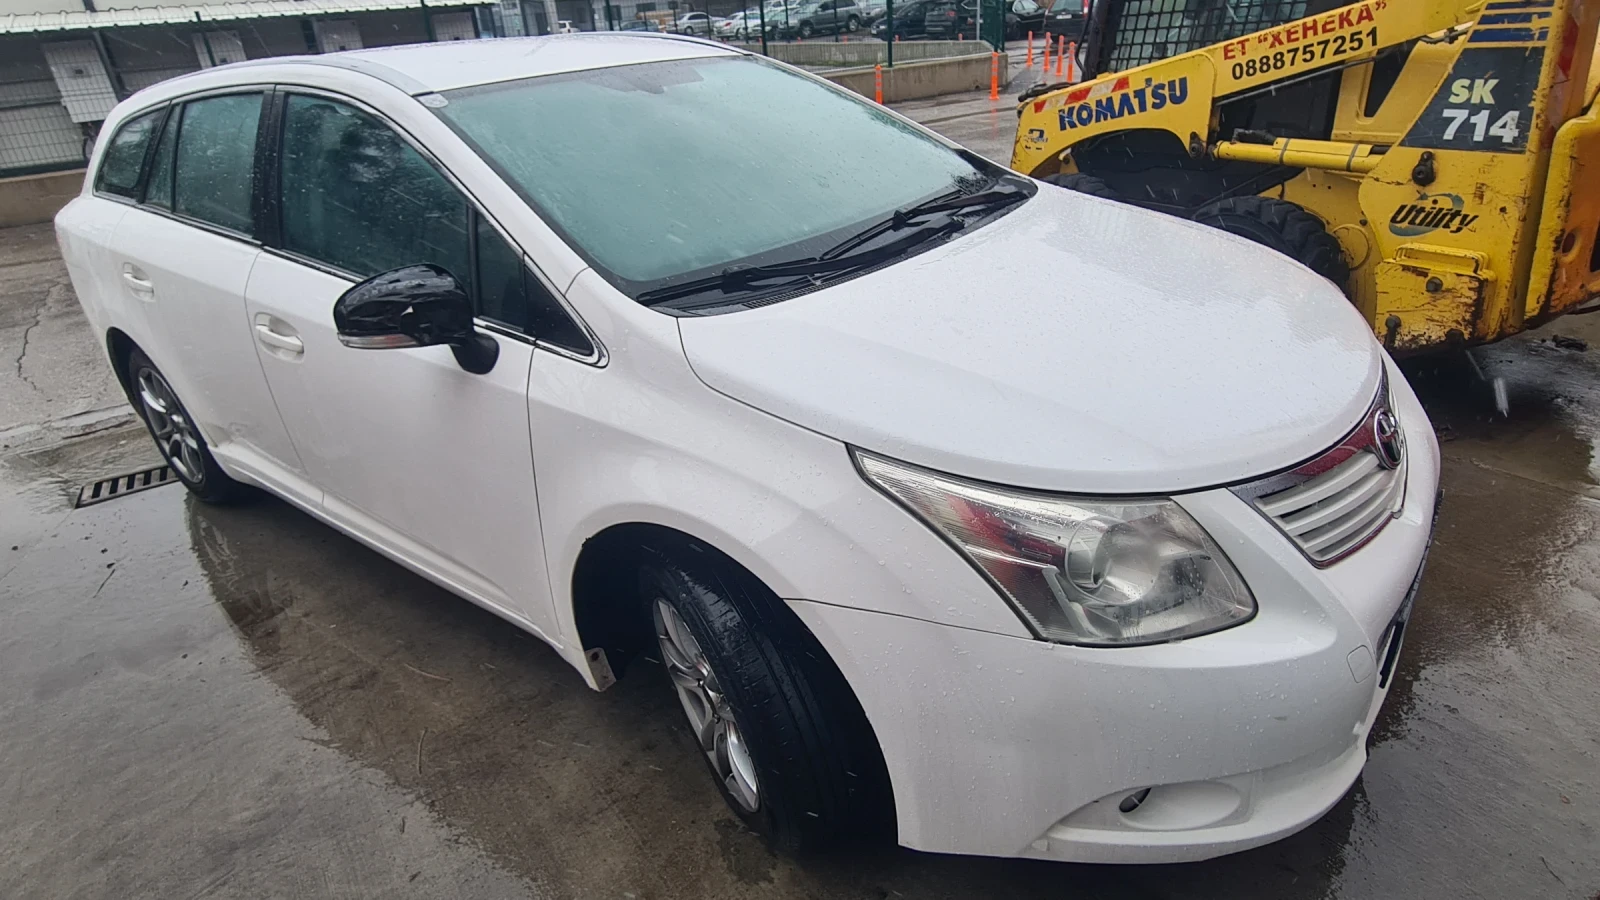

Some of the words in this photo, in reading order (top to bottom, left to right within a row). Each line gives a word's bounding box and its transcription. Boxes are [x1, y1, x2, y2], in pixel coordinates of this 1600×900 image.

[1232, 26, 1378, 80] 0888757251
[1058, 76, 1188, 131] KOMATSU
[1448, 78, 1500, 104] SK
[1442, 109, 1520, 143] 714
[1390, 198, 1479, 234] Utility
